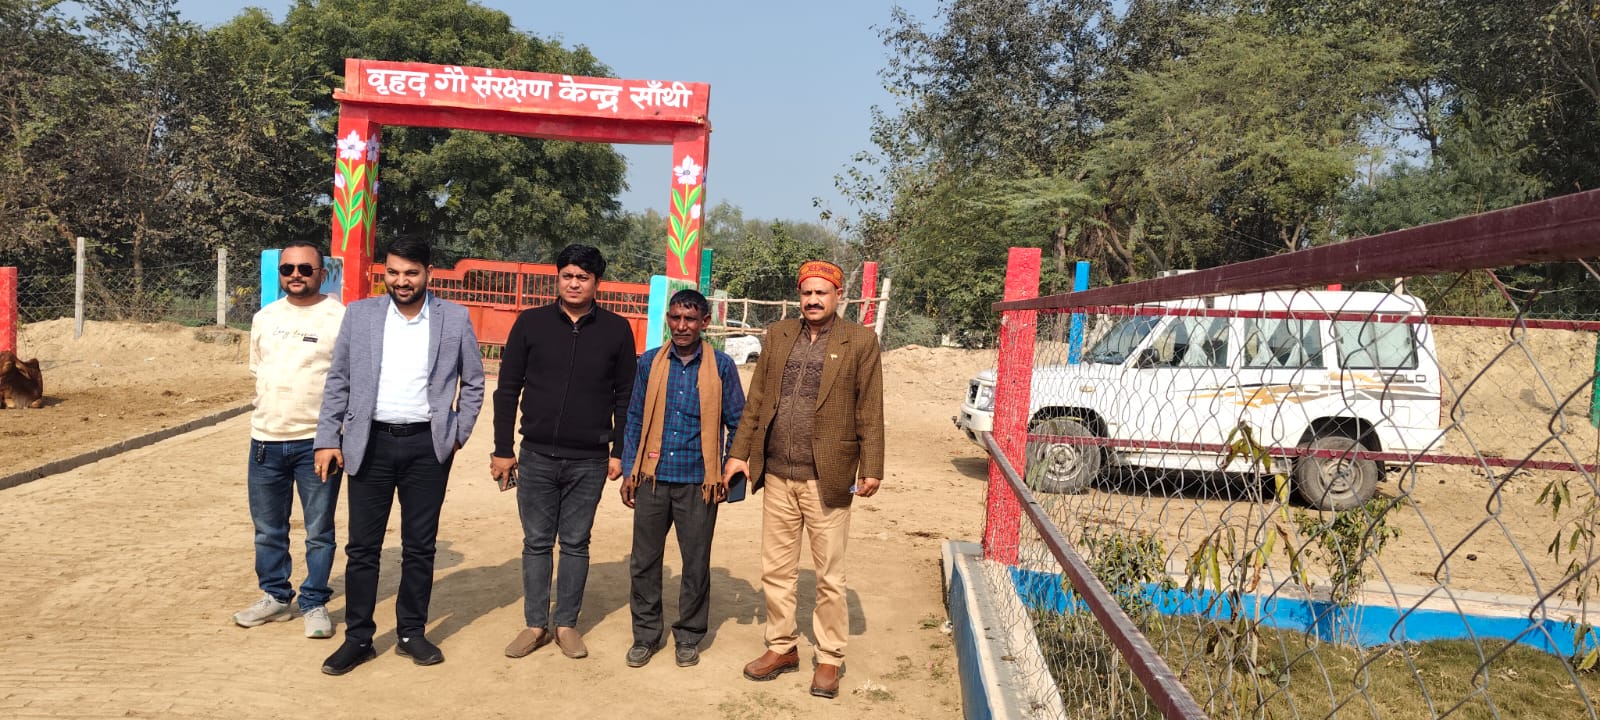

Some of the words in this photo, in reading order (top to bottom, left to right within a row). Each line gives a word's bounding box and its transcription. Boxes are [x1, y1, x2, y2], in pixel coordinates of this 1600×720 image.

[367, 68, 430, 98] वृहद
[472, 68, 552, 103] संरक्षण
[558, 75, 623, 112] केन्द्र
